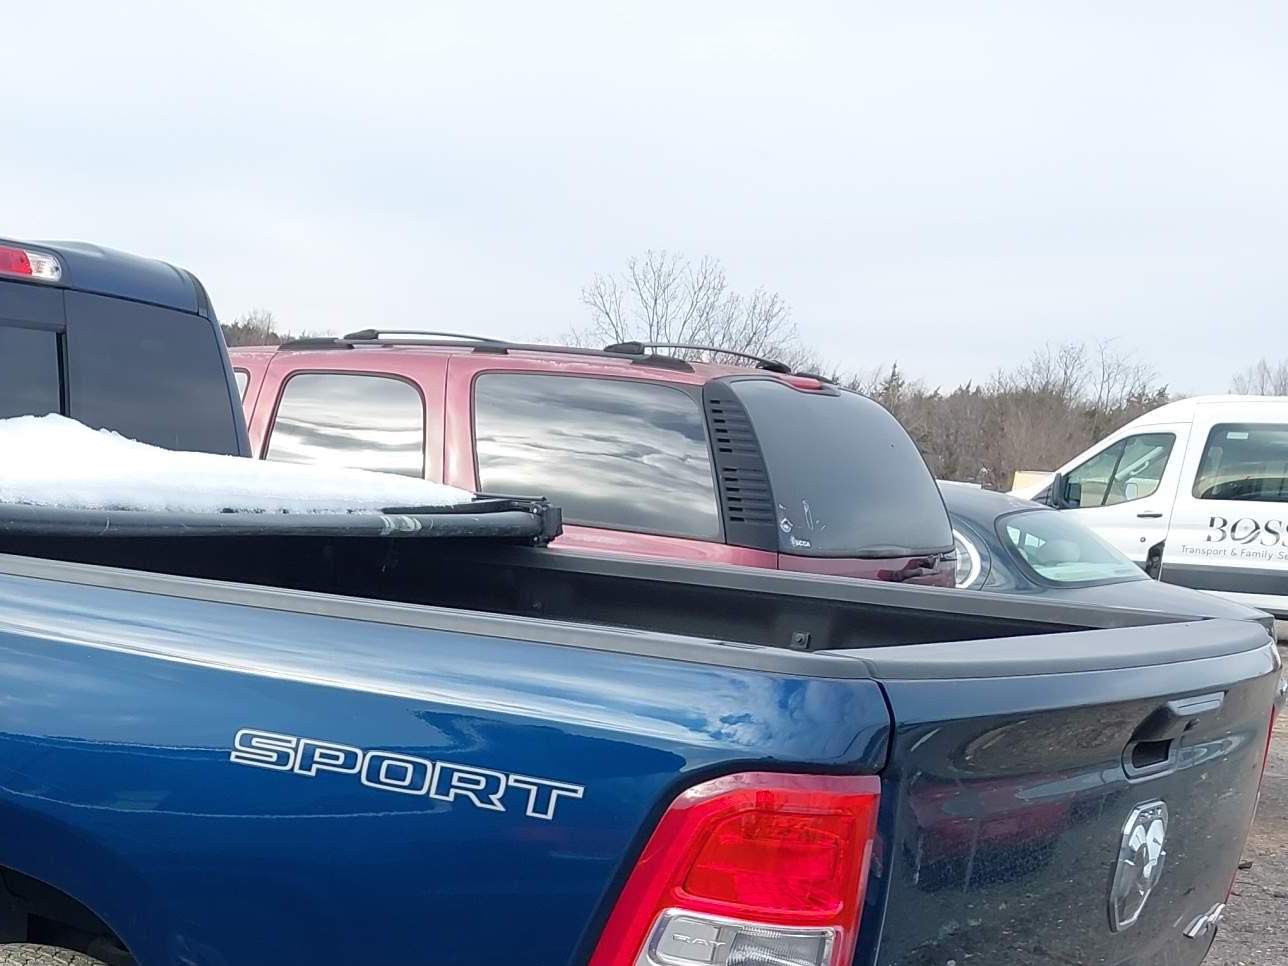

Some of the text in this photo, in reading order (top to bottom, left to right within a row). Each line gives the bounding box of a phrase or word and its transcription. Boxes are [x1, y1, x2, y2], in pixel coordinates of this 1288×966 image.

[1204, 515, 1288, 547] BOS
[1181, 544, 1227, 557] Transport
[1230, 548, 1239, 557] &
[1240, 548, 1274, 561] Family
[229, 727, 585, 821] SPORT
